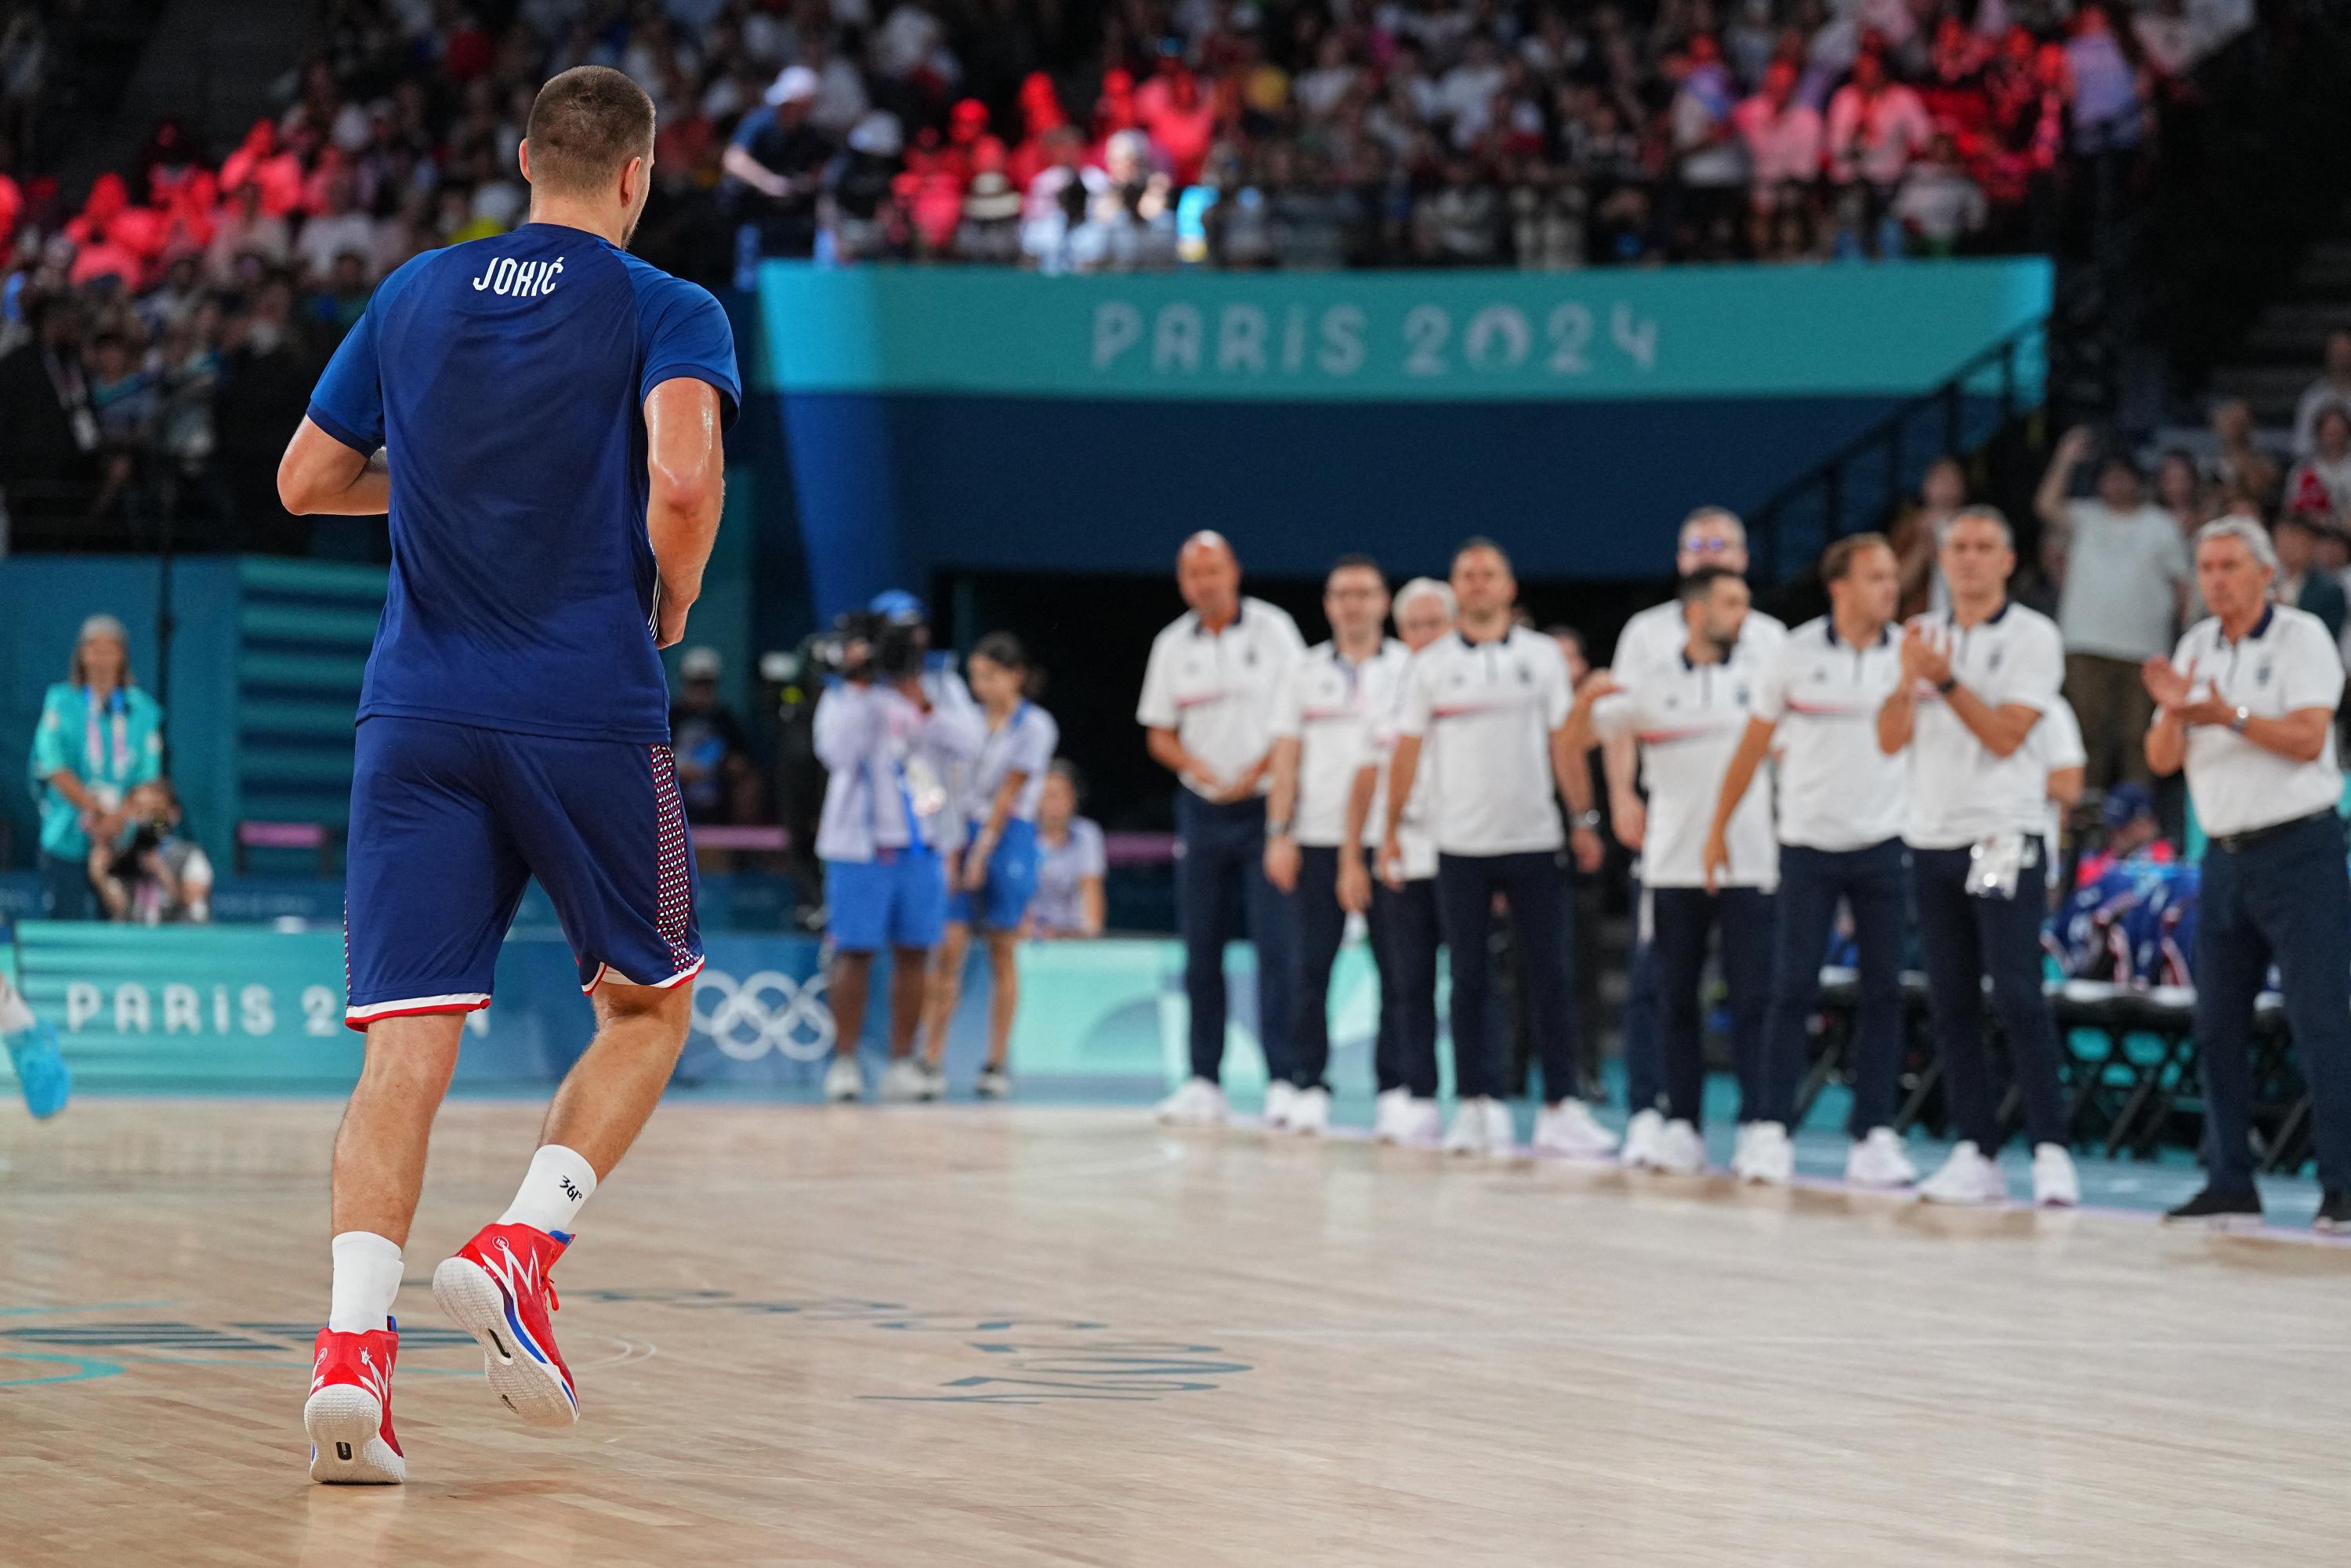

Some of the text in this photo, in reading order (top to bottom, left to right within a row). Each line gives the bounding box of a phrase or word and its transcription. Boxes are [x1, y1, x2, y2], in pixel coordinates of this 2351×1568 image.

[473, 256, 565, 297] JOKIĆ
[1092, 302, 1657, 375] PARIS 2024
[66, 981, 276, 1037] PARIS
